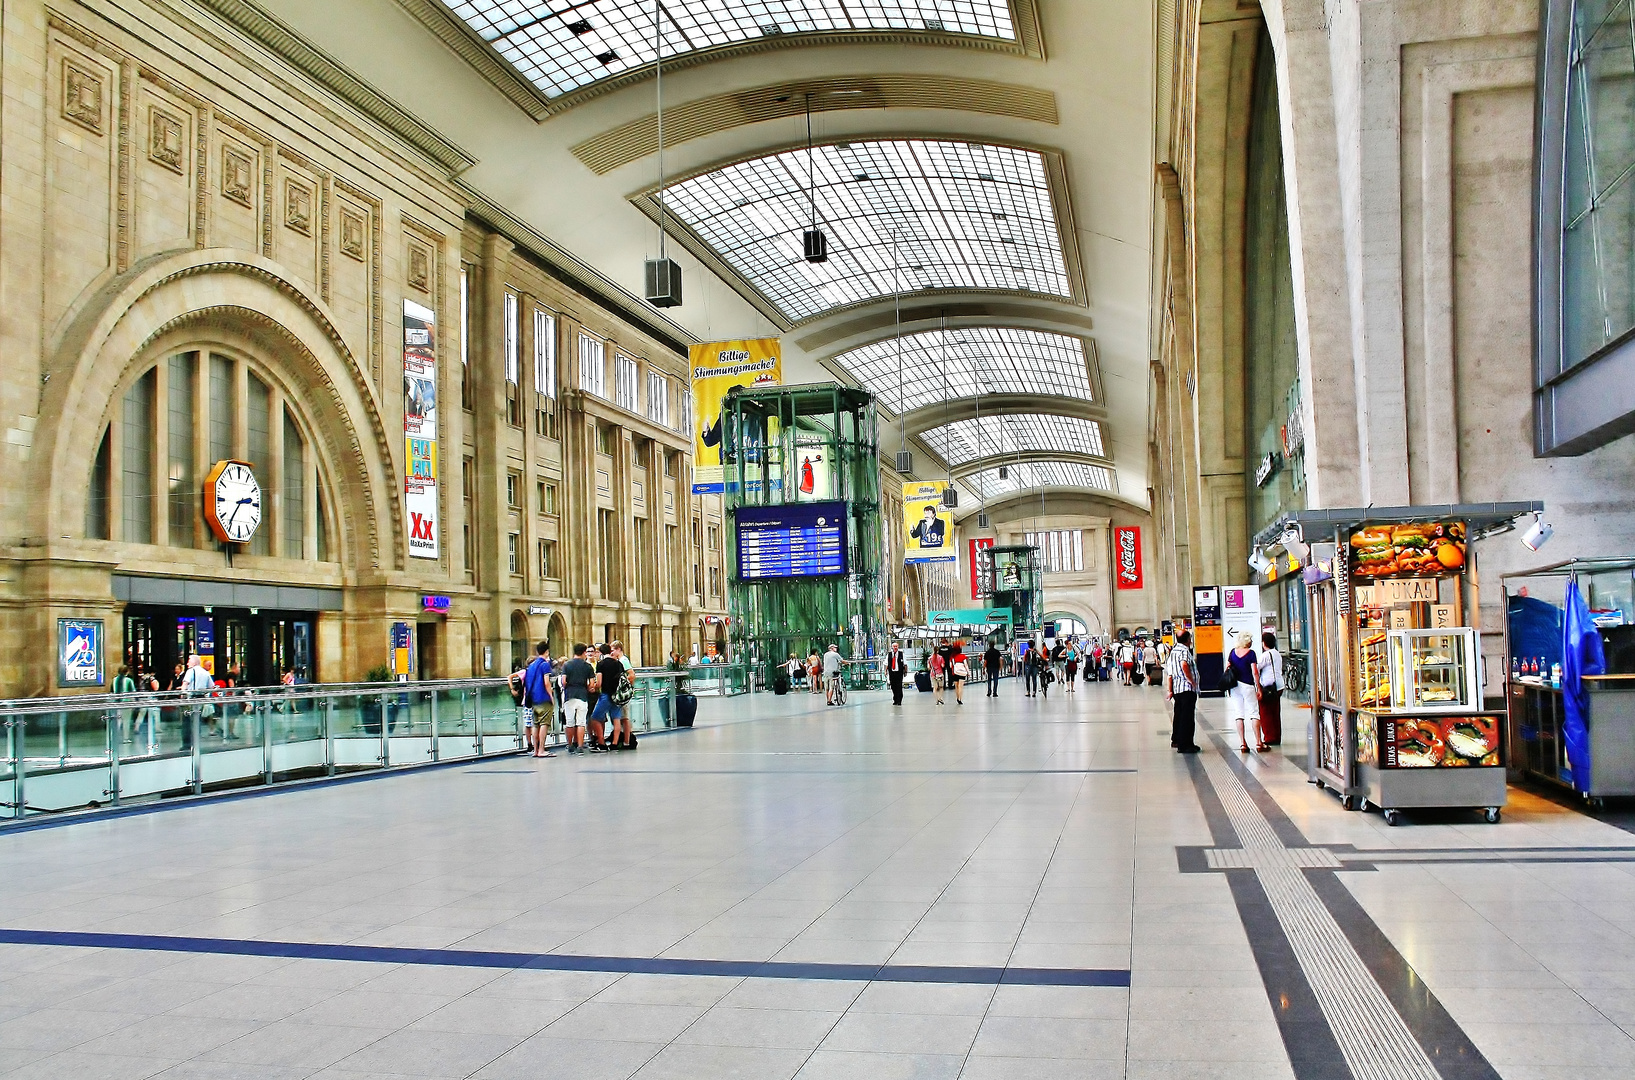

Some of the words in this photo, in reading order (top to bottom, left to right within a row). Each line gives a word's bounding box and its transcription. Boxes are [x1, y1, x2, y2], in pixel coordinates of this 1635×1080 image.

[694, 357, 775, 379] Stimmungsmache?
[719, 350, 749, 362] Billige
[411, 511, 433, 541] Xx
[1120, 529, 1135, 569] Coca-Cola
[1380, 580, 1433, 604] LUKAS
